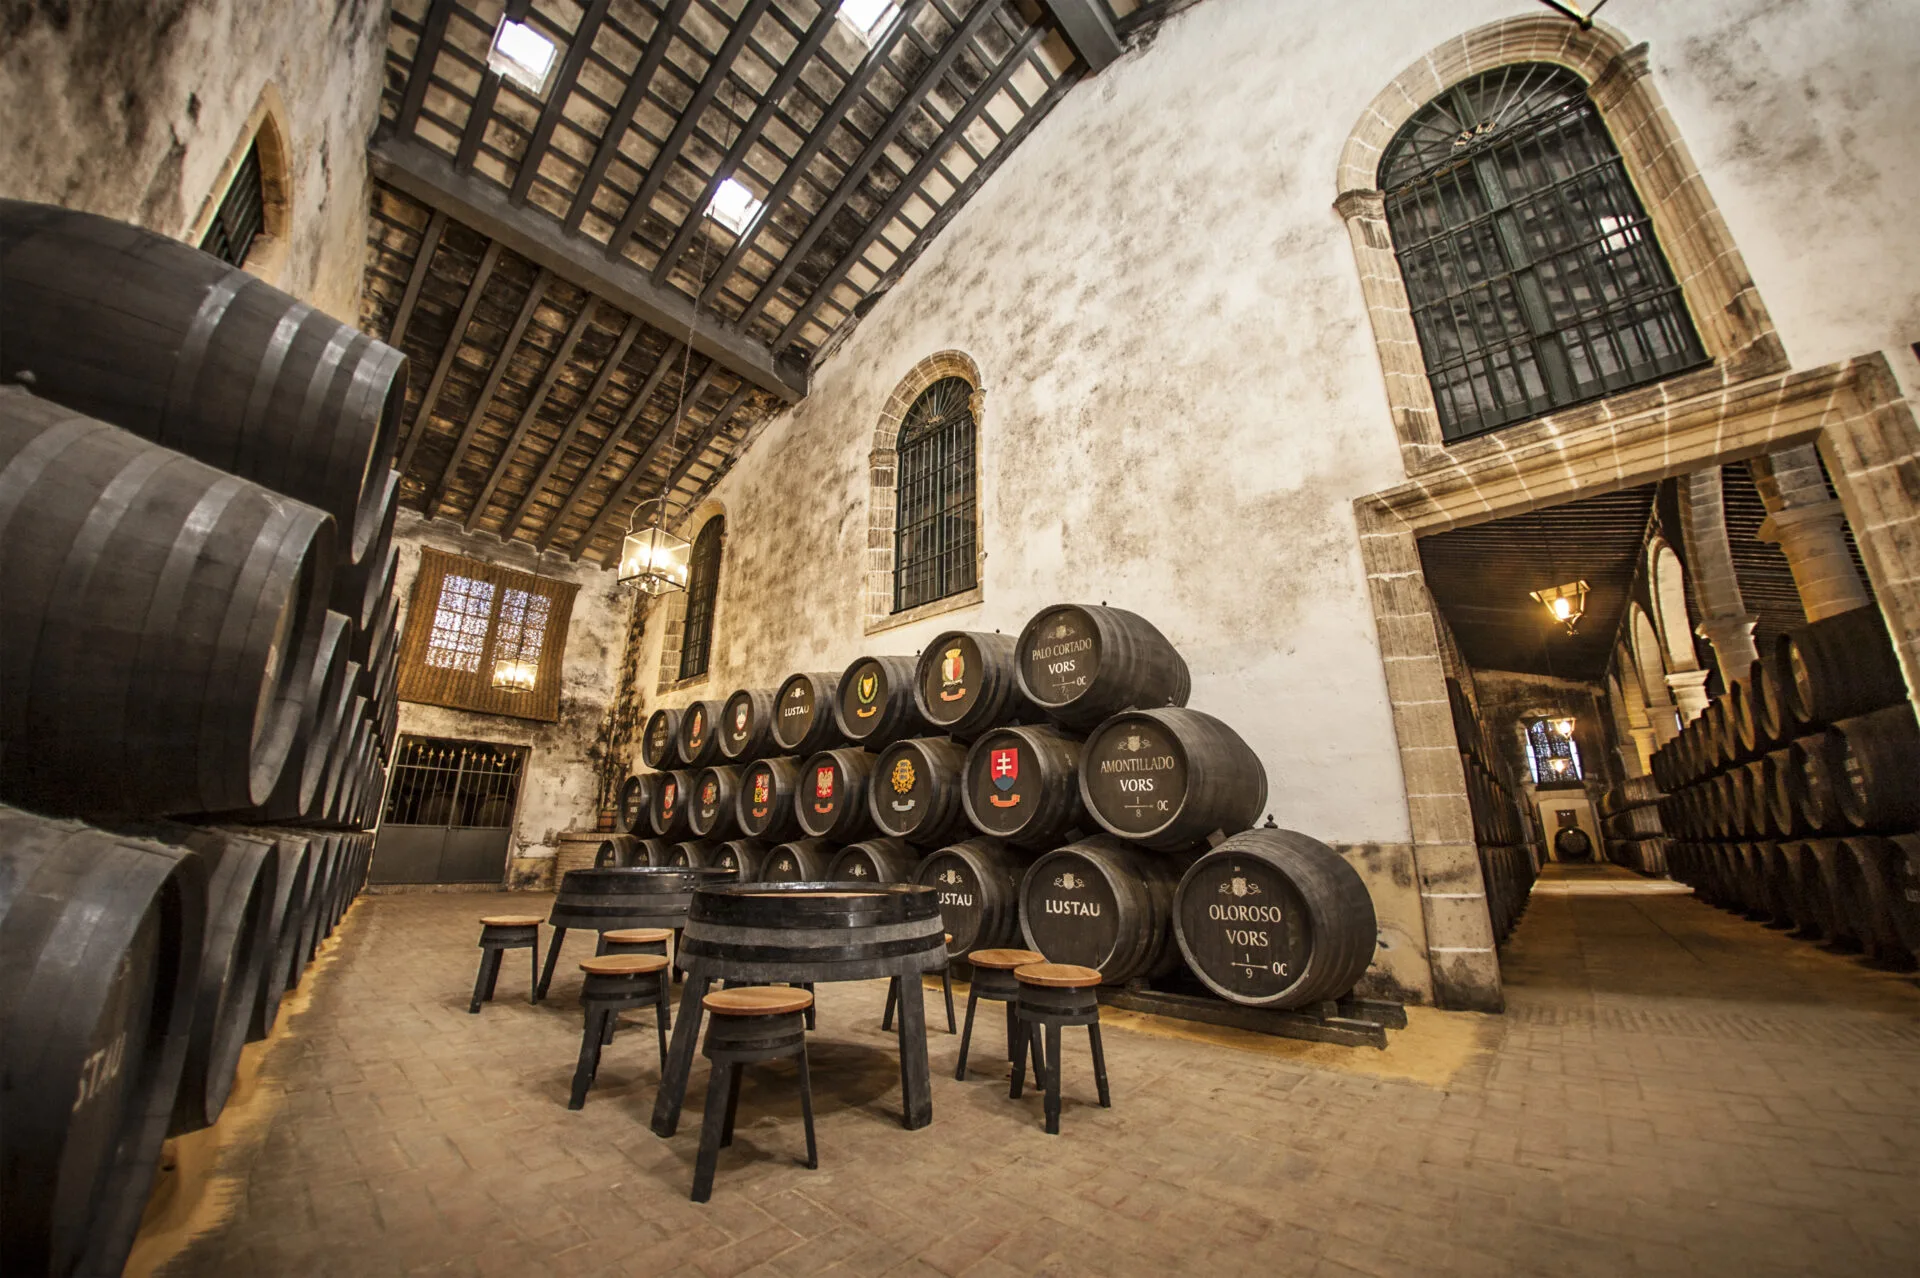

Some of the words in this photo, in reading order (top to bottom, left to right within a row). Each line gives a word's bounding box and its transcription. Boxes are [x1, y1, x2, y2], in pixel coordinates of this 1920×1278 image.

[1032, 647, 1052, 661] PALO
[1053, 637, 1092, 657] CORTADO
[1048, 660, 1076, 675] VORS
[1076, 675, 1087, 686] OC
[784, 704, 810, 717] LUSTAU
[1101, 756, 1174, 773] AMONTILLADO
[1120, 778, 1154, 792] VORS
[1135, 809, 1141, 817] 8
[1157, 800, 1168, 811] OC
[936, 892, 973, 907] USTAU
[1045, 900, 1101, 917] LUSTAU
[1209, 904, 1281, 923] OLOROSO
[1226, 929, 1268, 947] VORS
[1245, 953, 1250, 963] 1
[1245, 967, 1253, 979] 9
[1272, 961, 1287, 976] OC
[72, 1031, 127, 1113] STAU
